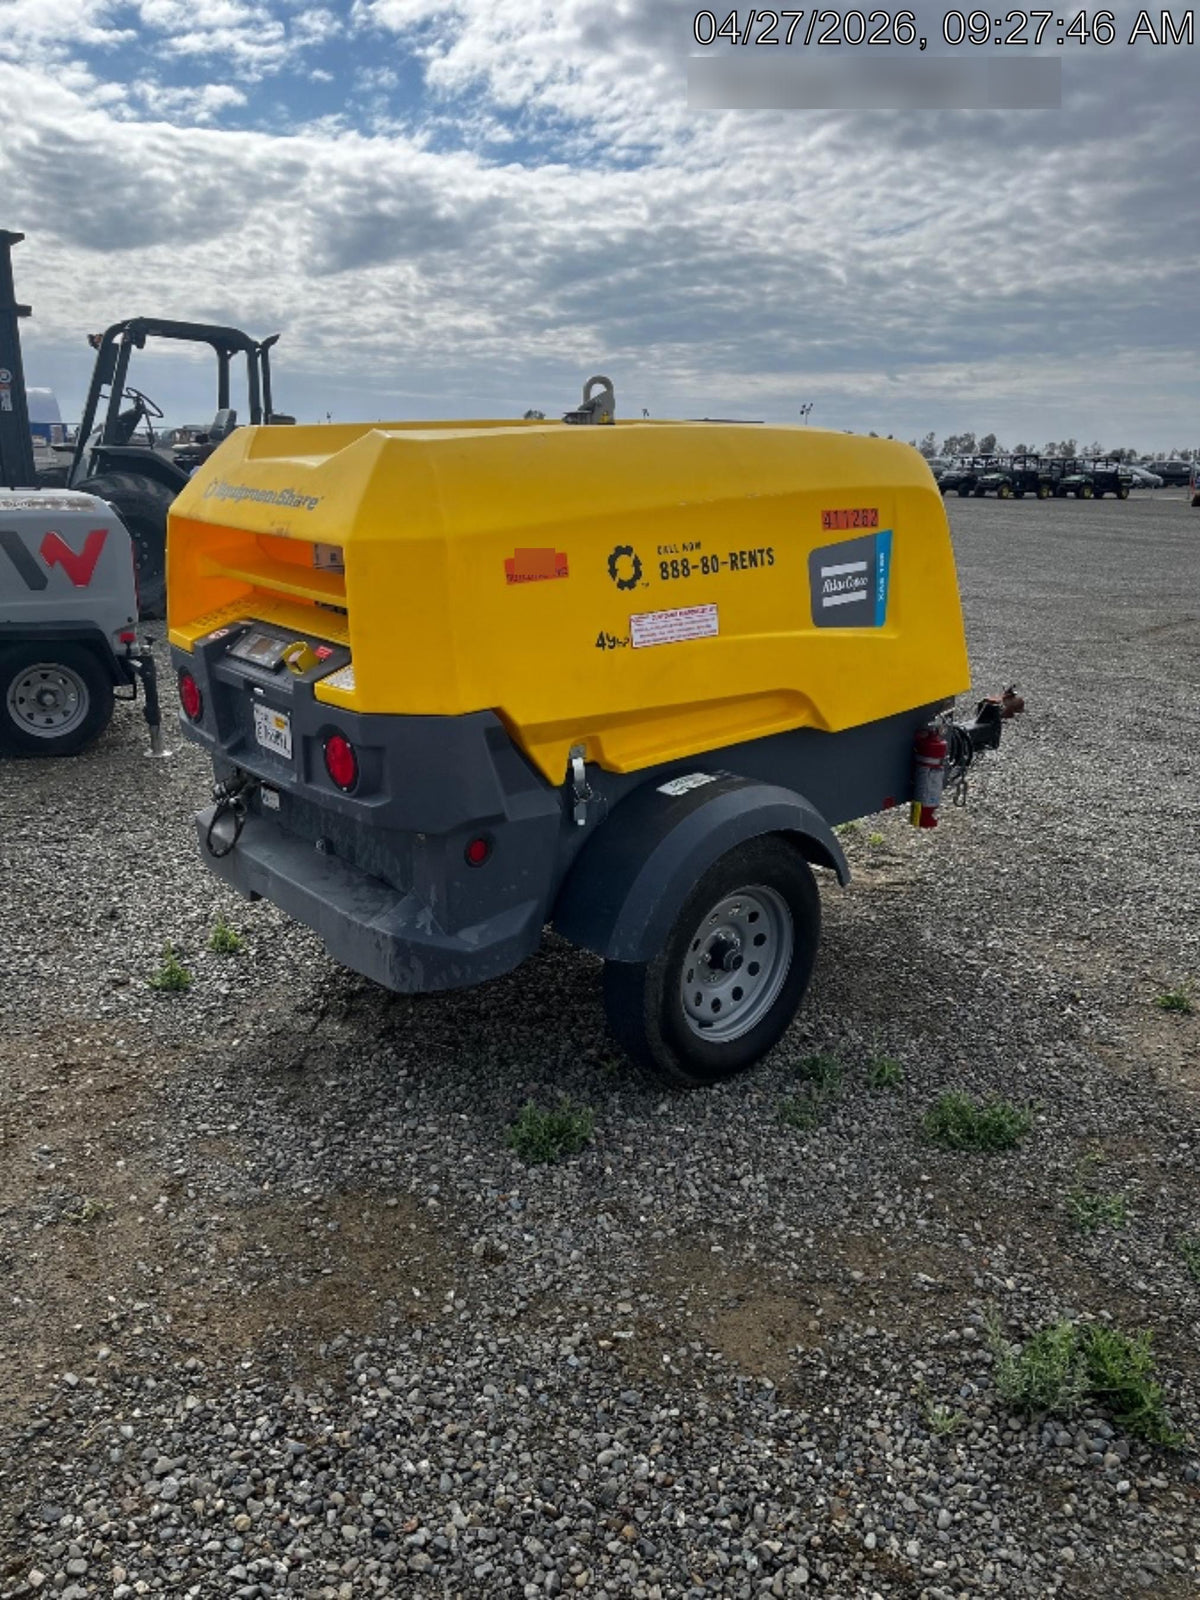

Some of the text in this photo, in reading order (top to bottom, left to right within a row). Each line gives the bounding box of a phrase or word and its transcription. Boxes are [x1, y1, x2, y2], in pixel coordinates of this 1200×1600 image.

[657, 540, 702, 556] CALL NOW
[659, 547, 775, 581] 888-80-RENTS
